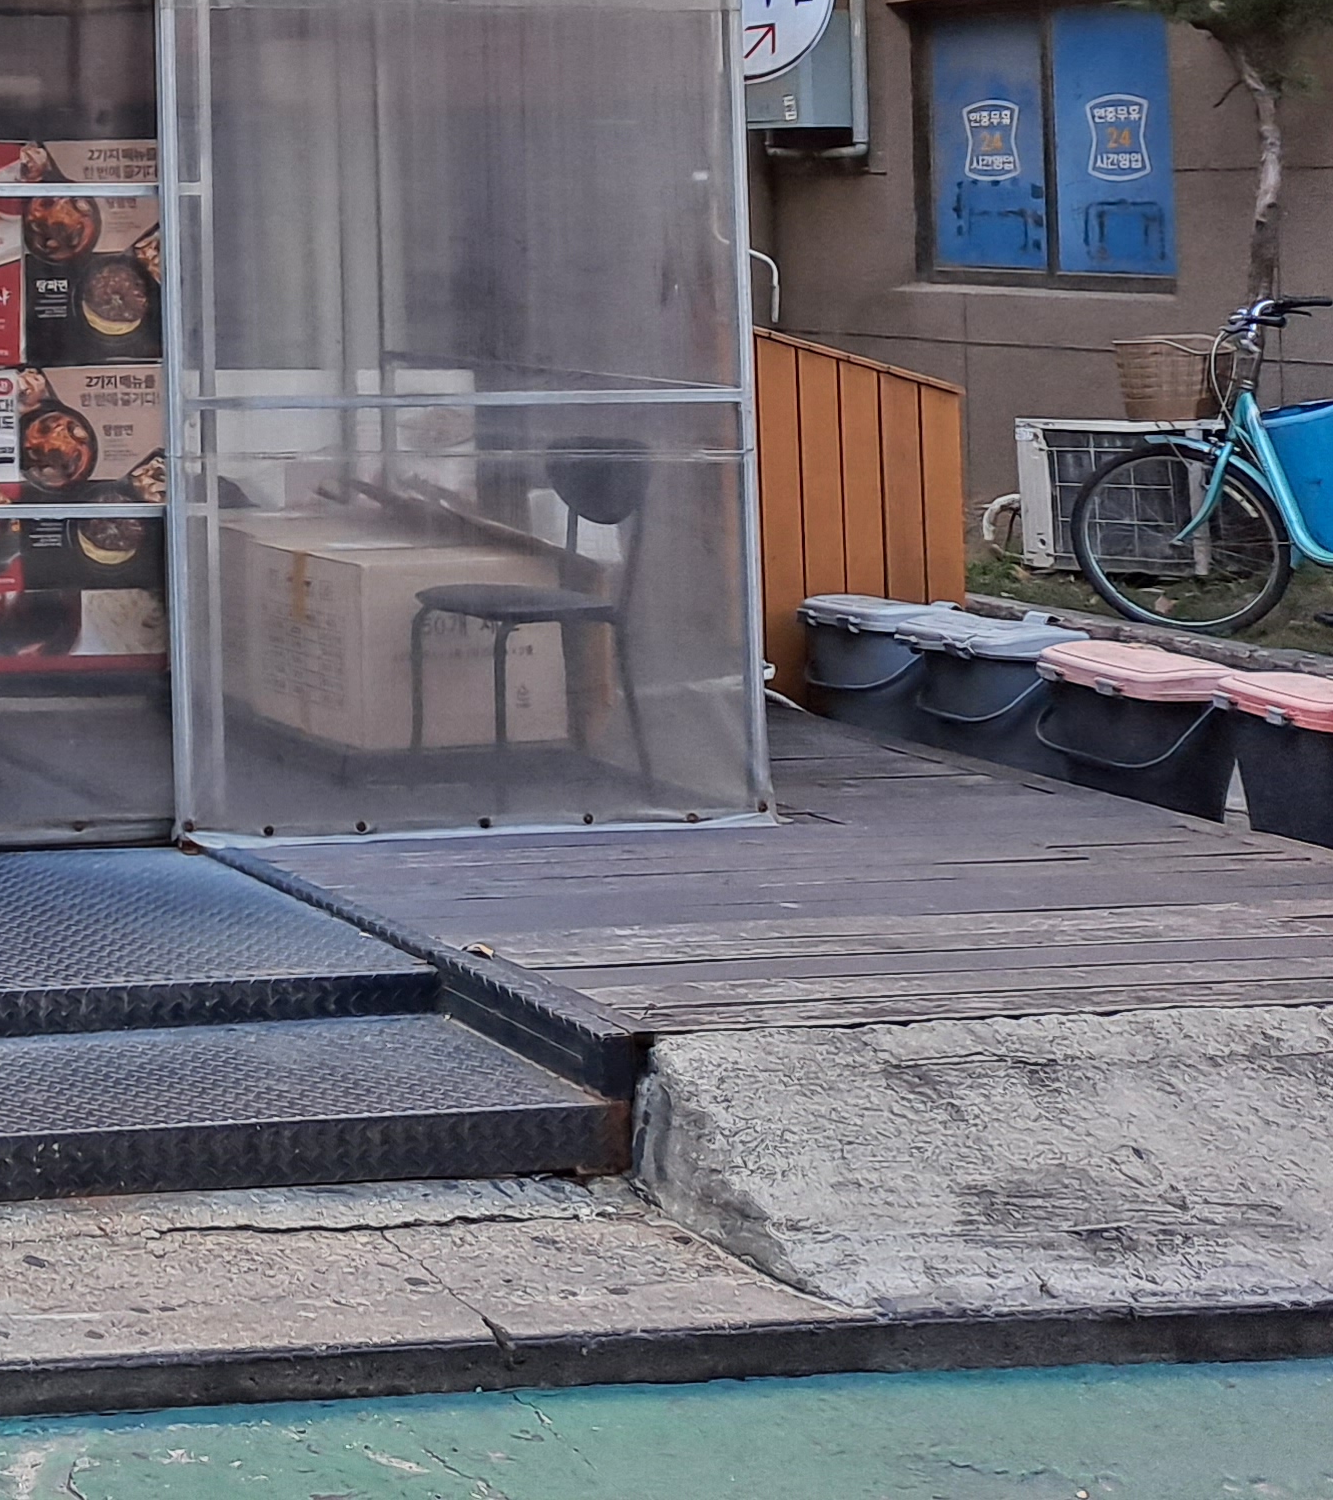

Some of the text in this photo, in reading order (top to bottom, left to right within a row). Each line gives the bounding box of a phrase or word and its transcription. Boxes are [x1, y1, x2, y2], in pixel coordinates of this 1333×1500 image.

[980, 132, 1003, 151] 24
[1106, 128, 1131, 149] 24
[1096, 152, 1143, 170] 시간영업
